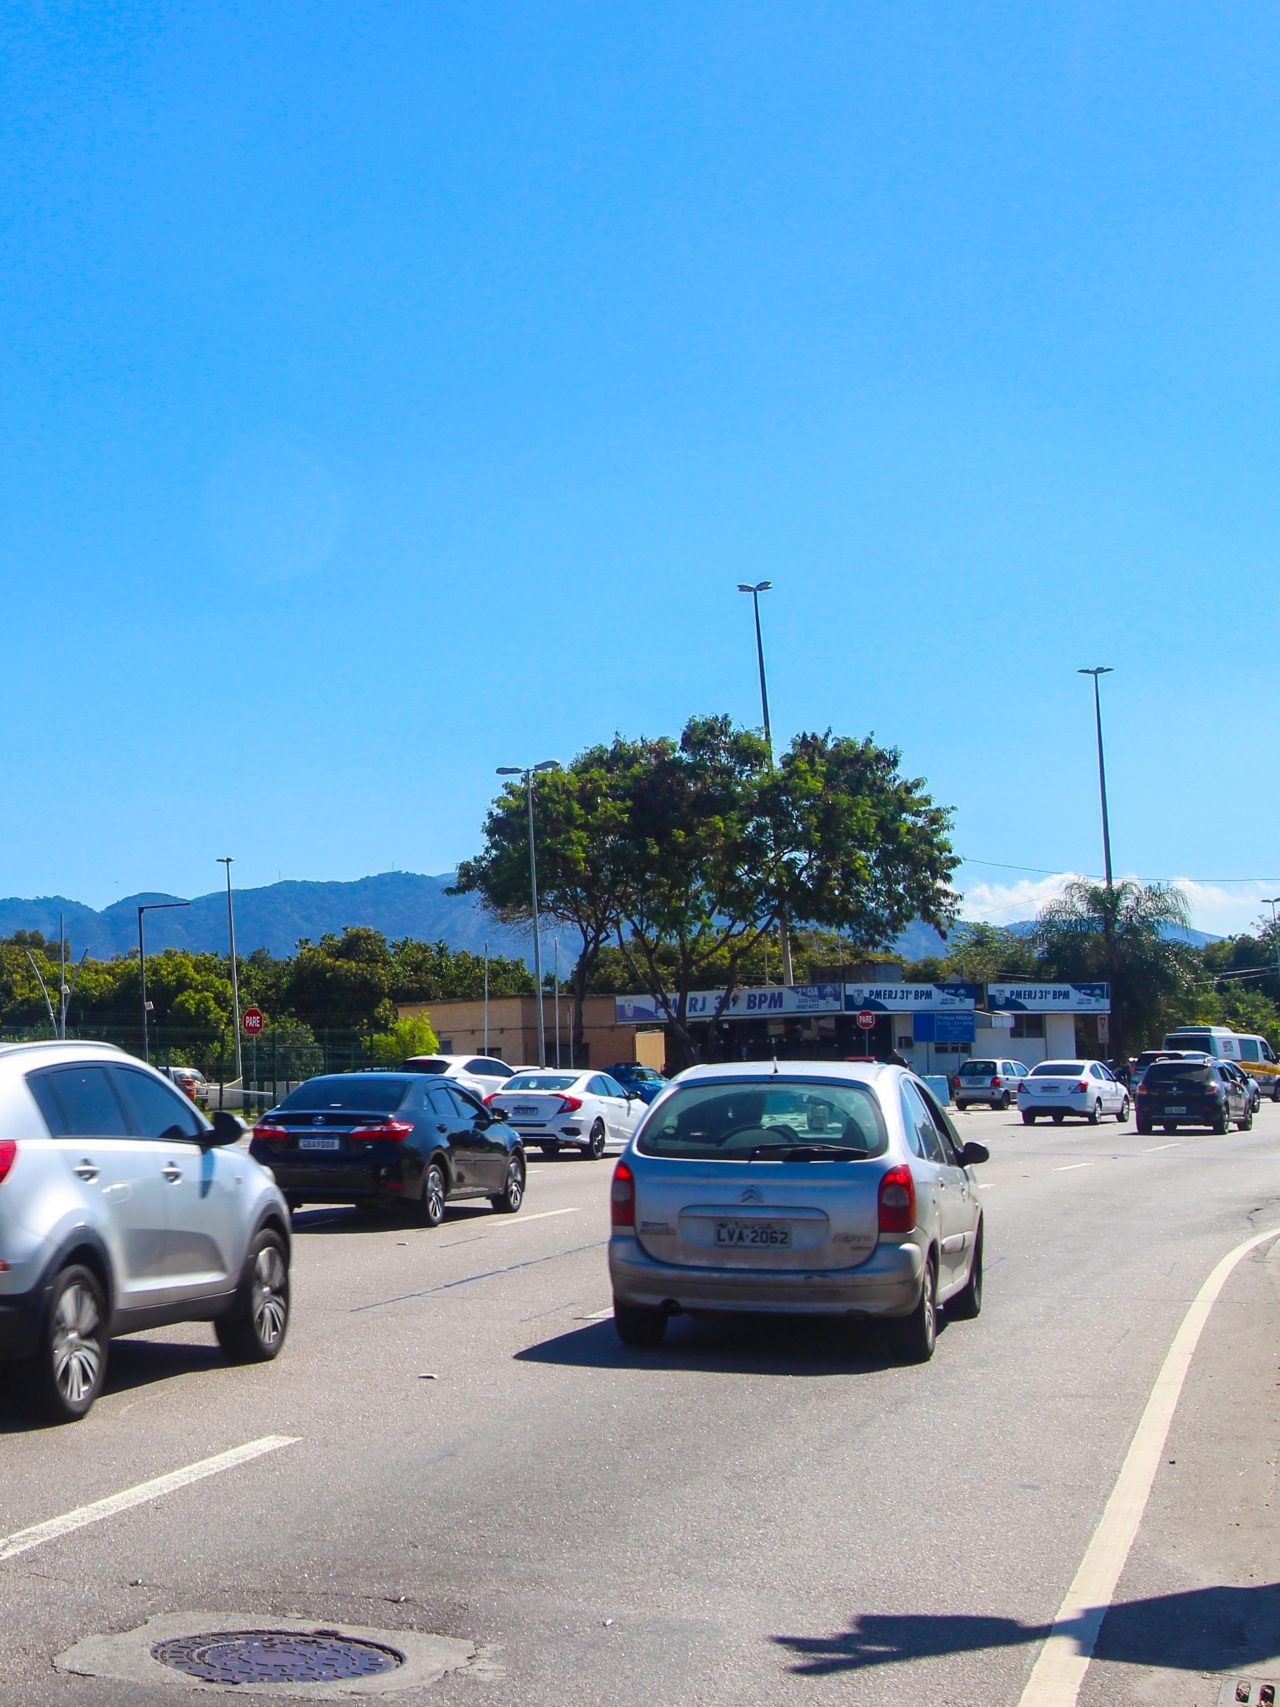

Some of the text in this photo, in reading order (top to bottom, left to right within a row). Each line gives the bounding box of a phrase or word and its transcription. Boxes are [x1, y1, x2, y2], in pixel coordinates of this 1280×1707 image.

[869, 989, 898, 1000] PMERJ
[913, 989, 933, 1000] BPM
[1009, 990, 1037, 1000] PMERJ
[1052, 990, 1070, 1000] BPM
[746, 992, 784, 1010] BPM
[245, 1016, 260, 1027] PARE
[858, 1015, 872, 1024] PARE
